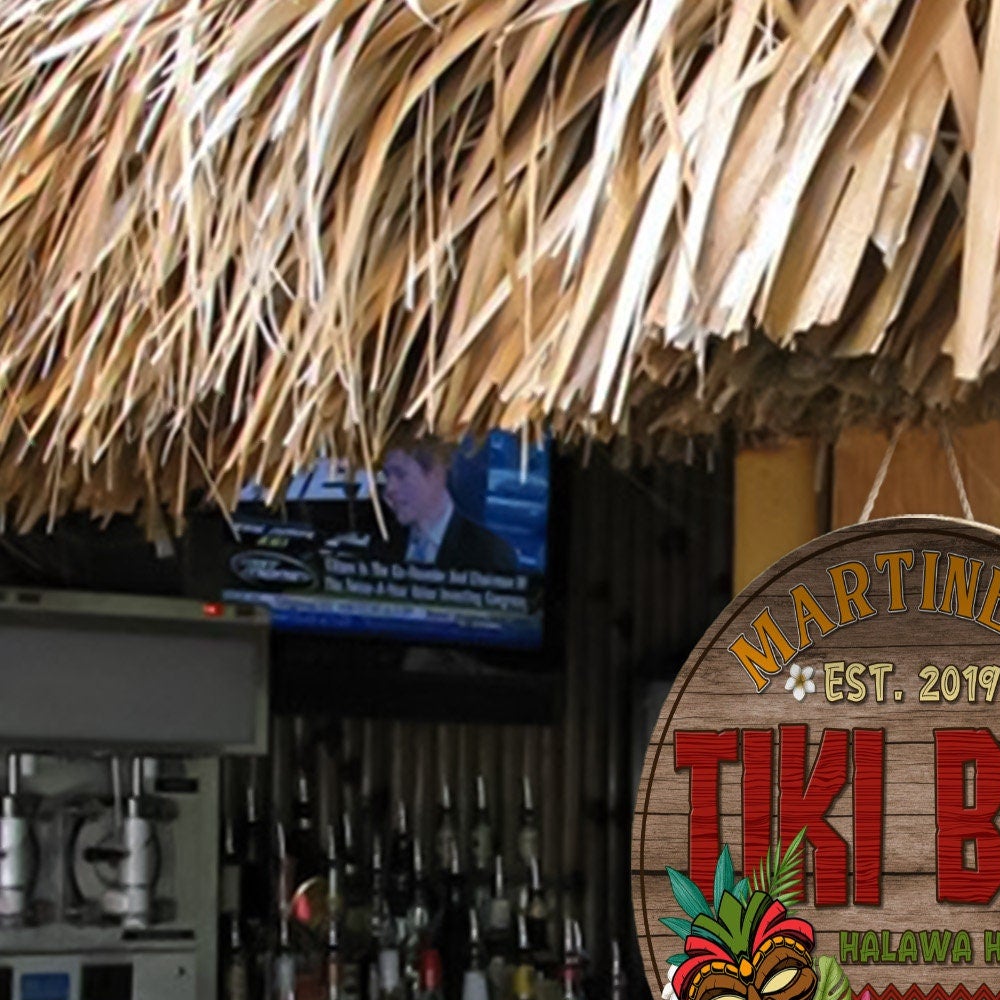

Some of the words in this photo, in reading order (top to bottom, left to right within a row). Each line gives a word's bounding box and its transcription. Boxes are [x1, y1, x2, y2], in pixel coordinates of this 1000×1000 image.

[823, 661, 904, 702] EST.
[674, 723, 885, 908] TIKI
[839, 930, 972, 963] HALAWA
